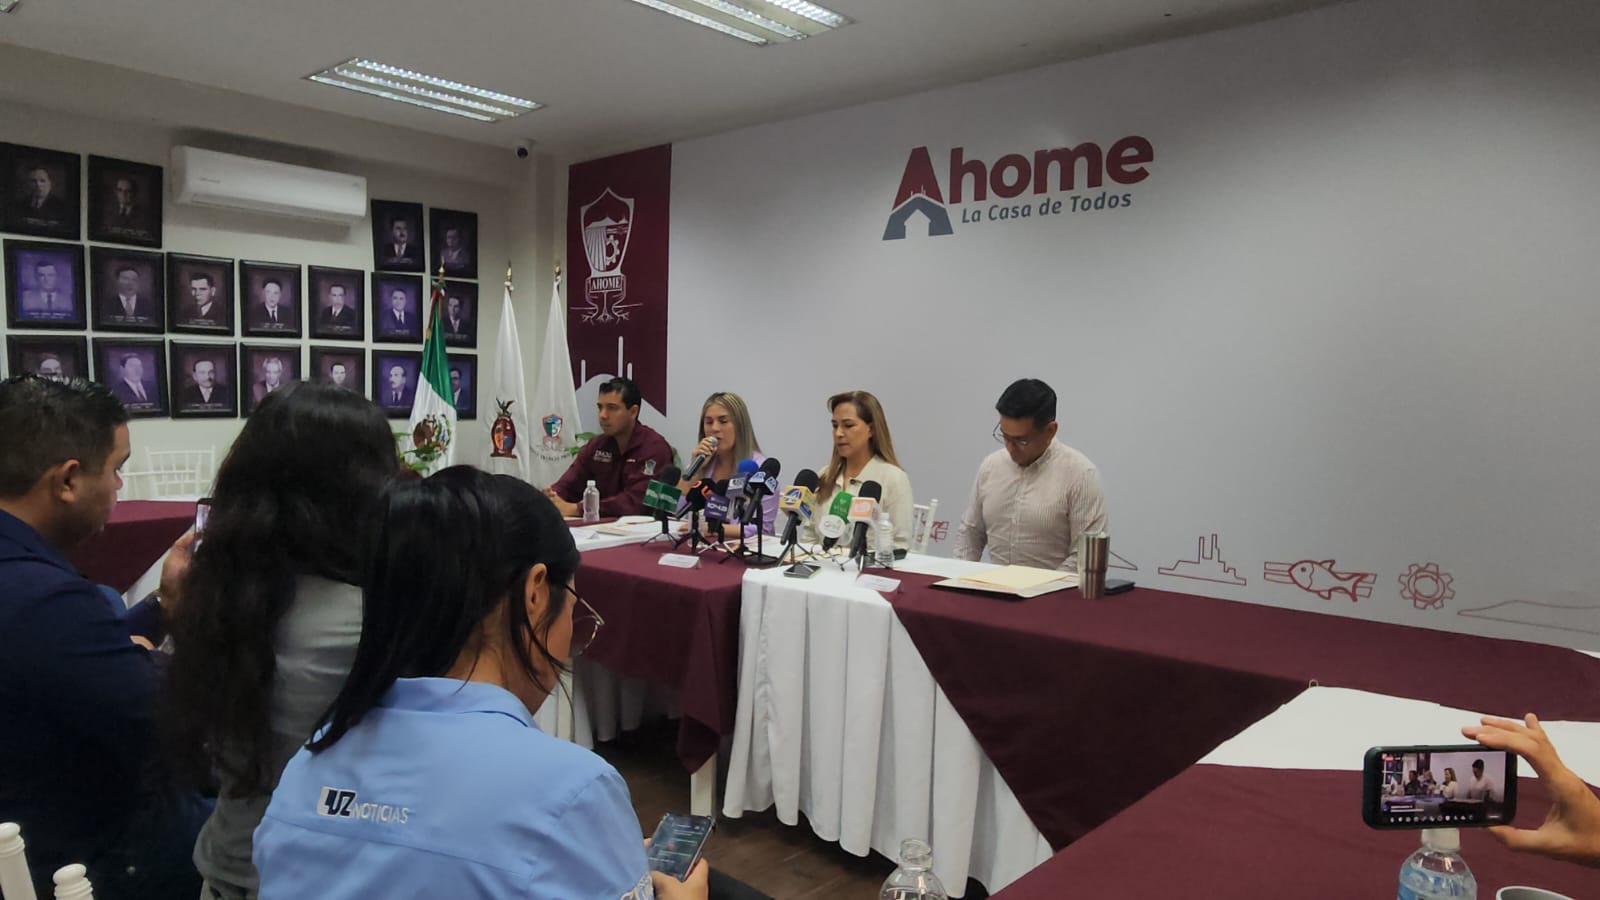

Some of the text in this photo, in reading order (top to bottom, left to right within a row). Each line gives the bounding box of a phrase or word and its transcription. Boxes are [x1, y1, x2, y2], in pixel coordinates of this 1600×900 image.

[882, 136, 1154, 241] Ahome
[962, 192, 1132, 223] La Casa de Todos
[591, 277, 621, 290] AHOME
[352, 802, 409, 824] NOTICIAS
